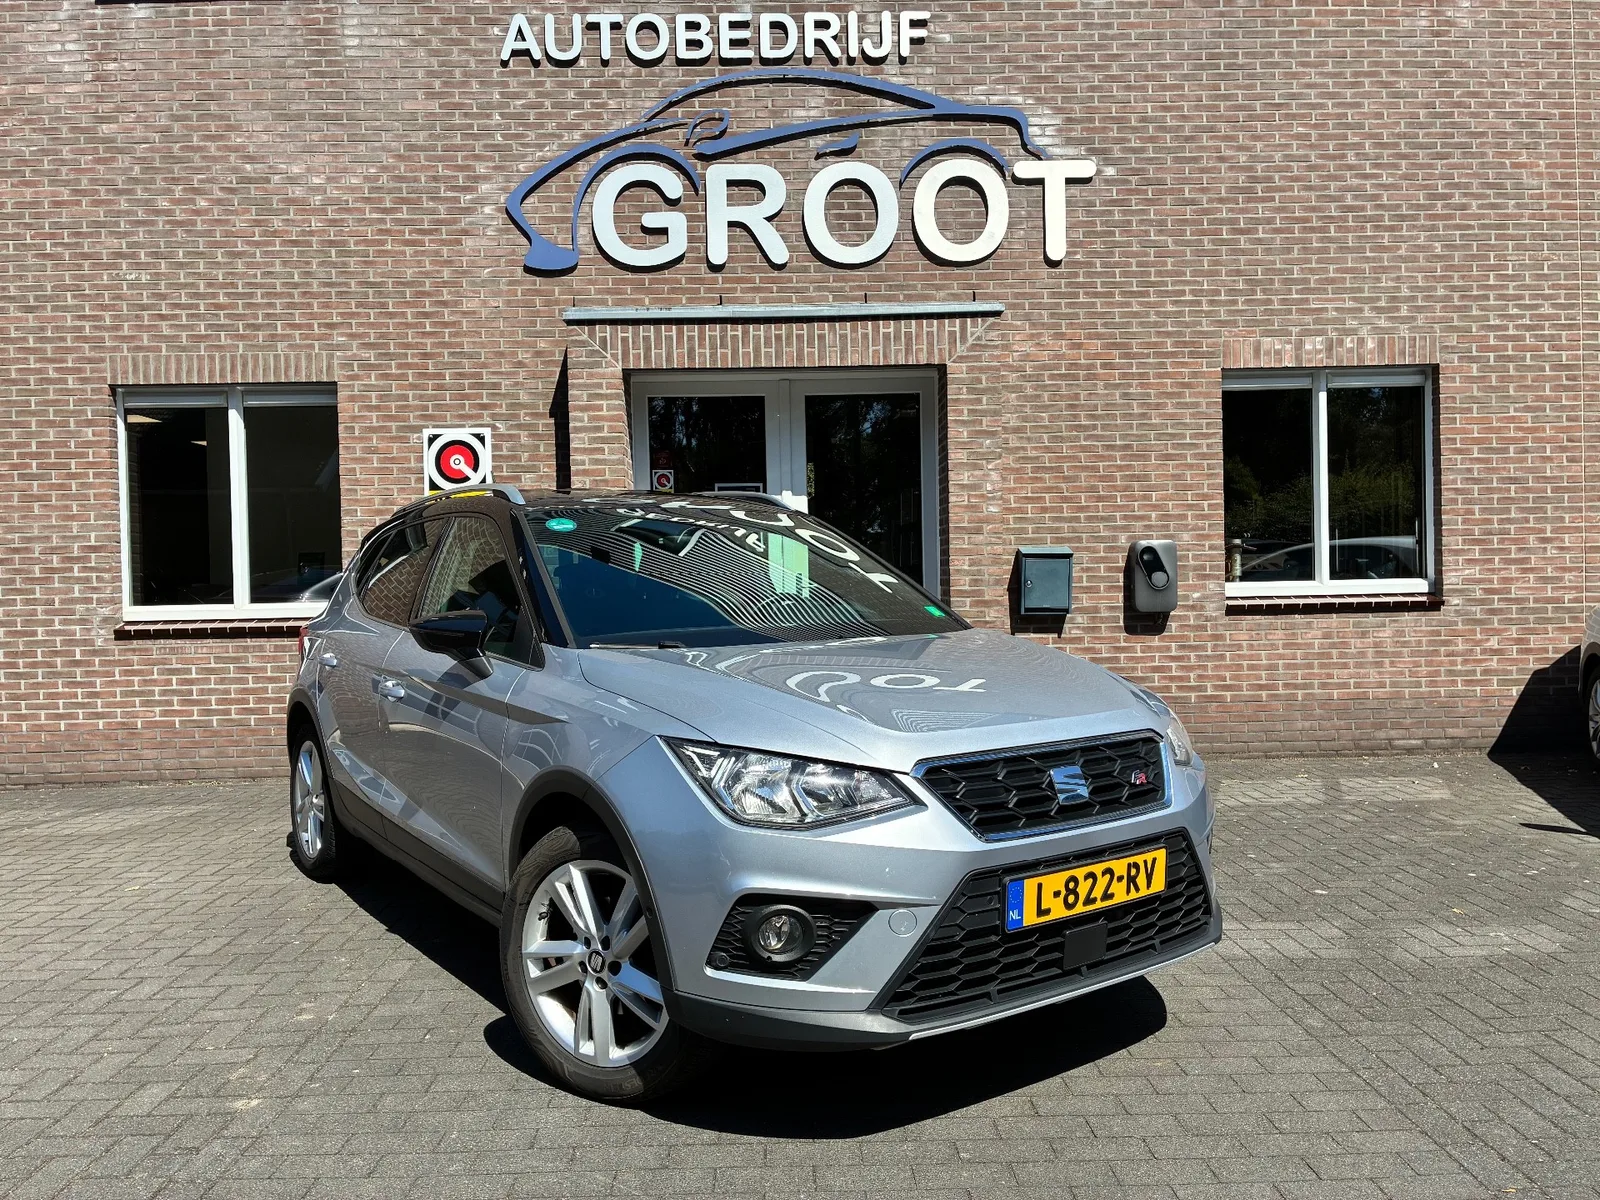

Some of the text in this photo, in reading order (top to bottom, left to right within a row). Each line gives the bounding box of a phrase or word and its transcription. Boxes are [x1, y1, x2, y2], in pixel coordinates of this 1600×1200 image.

[500, 11, 931, 63] AUTOBEDRIJF
[592, 160, 1096, 267] GROOT
[1036, 857, 1157, 918] L-822-RV
[1009, 910, 1022, 922] NL
